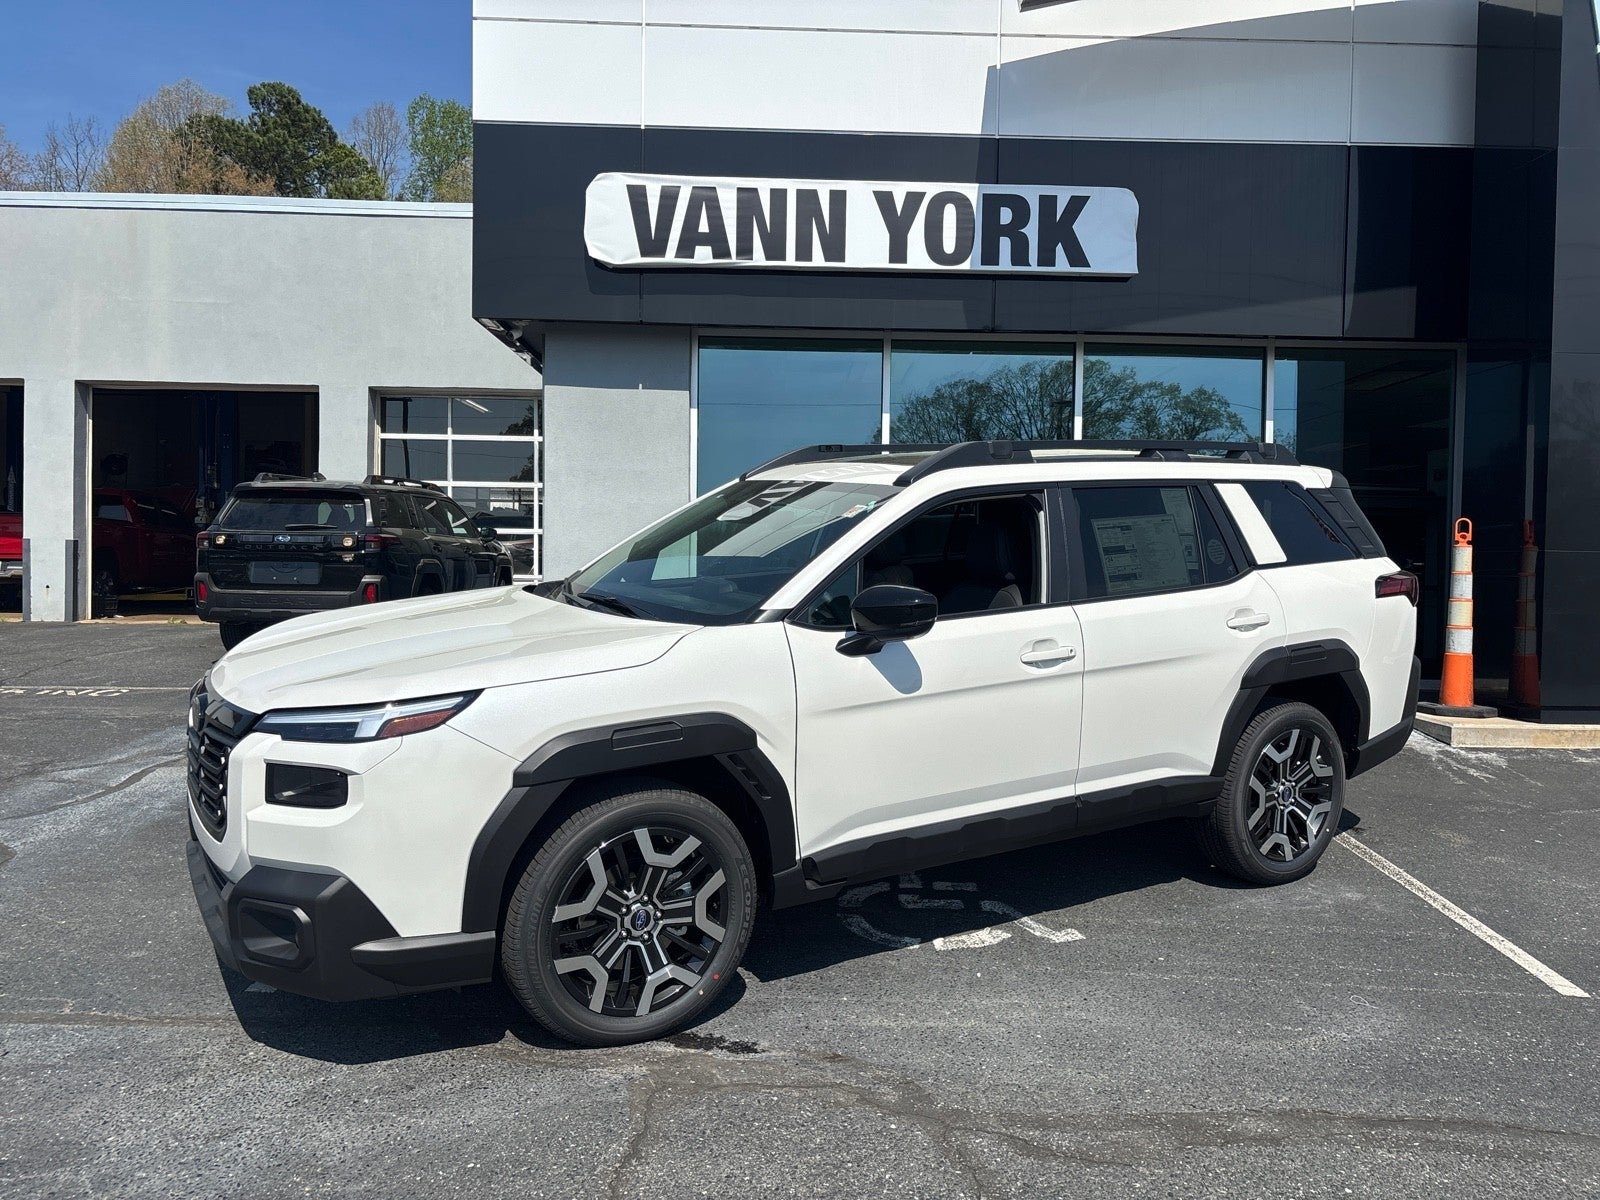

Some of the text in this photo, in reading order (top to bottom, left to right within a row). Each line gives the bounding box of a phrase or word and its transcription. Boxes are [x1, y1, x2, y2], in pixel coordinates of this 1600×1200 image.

[626, 184, 1091, 268] VANN YORK
[243, 543, 322, 551] OUTBACK
